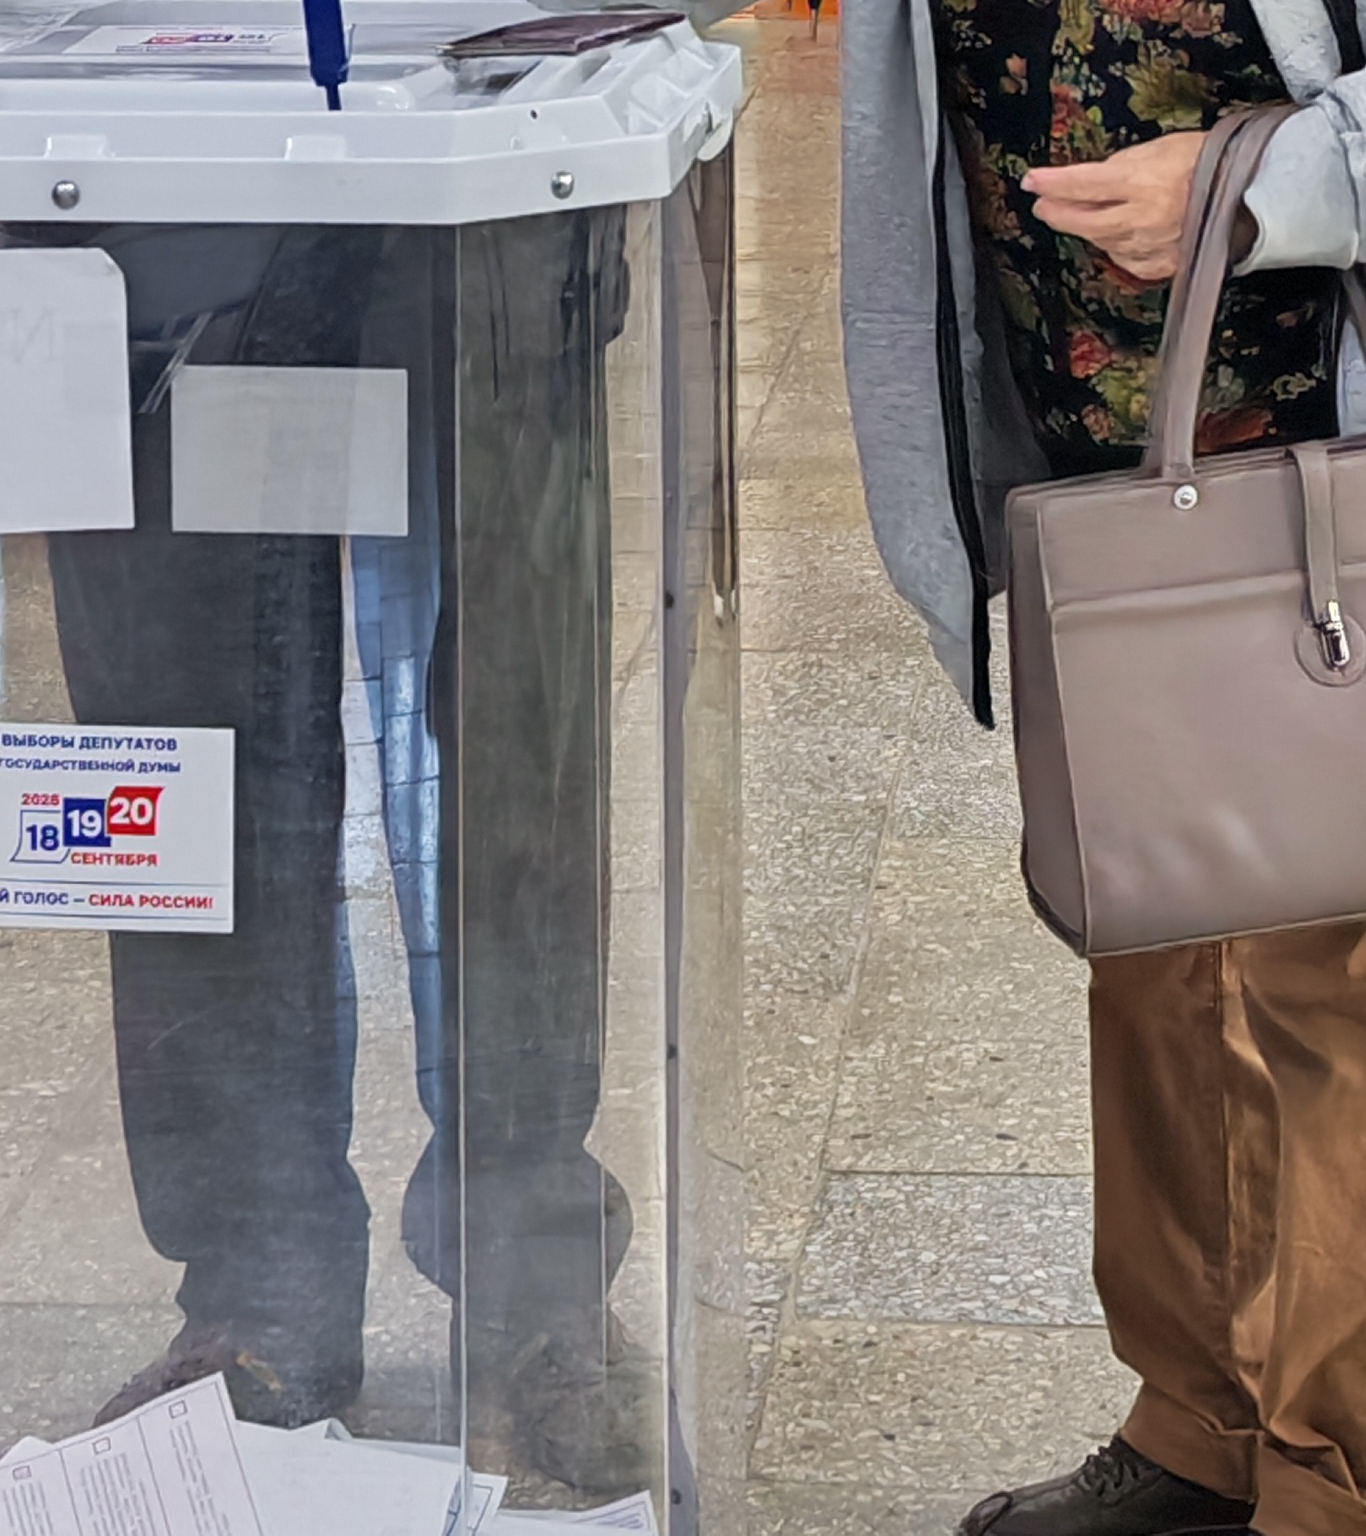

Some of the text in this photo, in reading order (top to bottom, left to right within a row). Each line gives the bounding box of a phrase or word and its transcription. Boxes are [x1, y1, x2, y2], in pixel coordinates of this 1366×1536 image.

[1, 733, 178, 752] ВЫБОРЫ ДЕПУТАТОВ
[137, 761, 181, 774] ДУМЫ
[109, 797, 154, 825] 20
[26, 809, 103, 851] 18 19
[70, 852, 158, 867] СЕНТЯБРЯ
[14, 891, 69, 906] ГОЛОС
[88, 893, 135, 908] СИЛА
[139, 894, 214, 910] РОССИИ!
